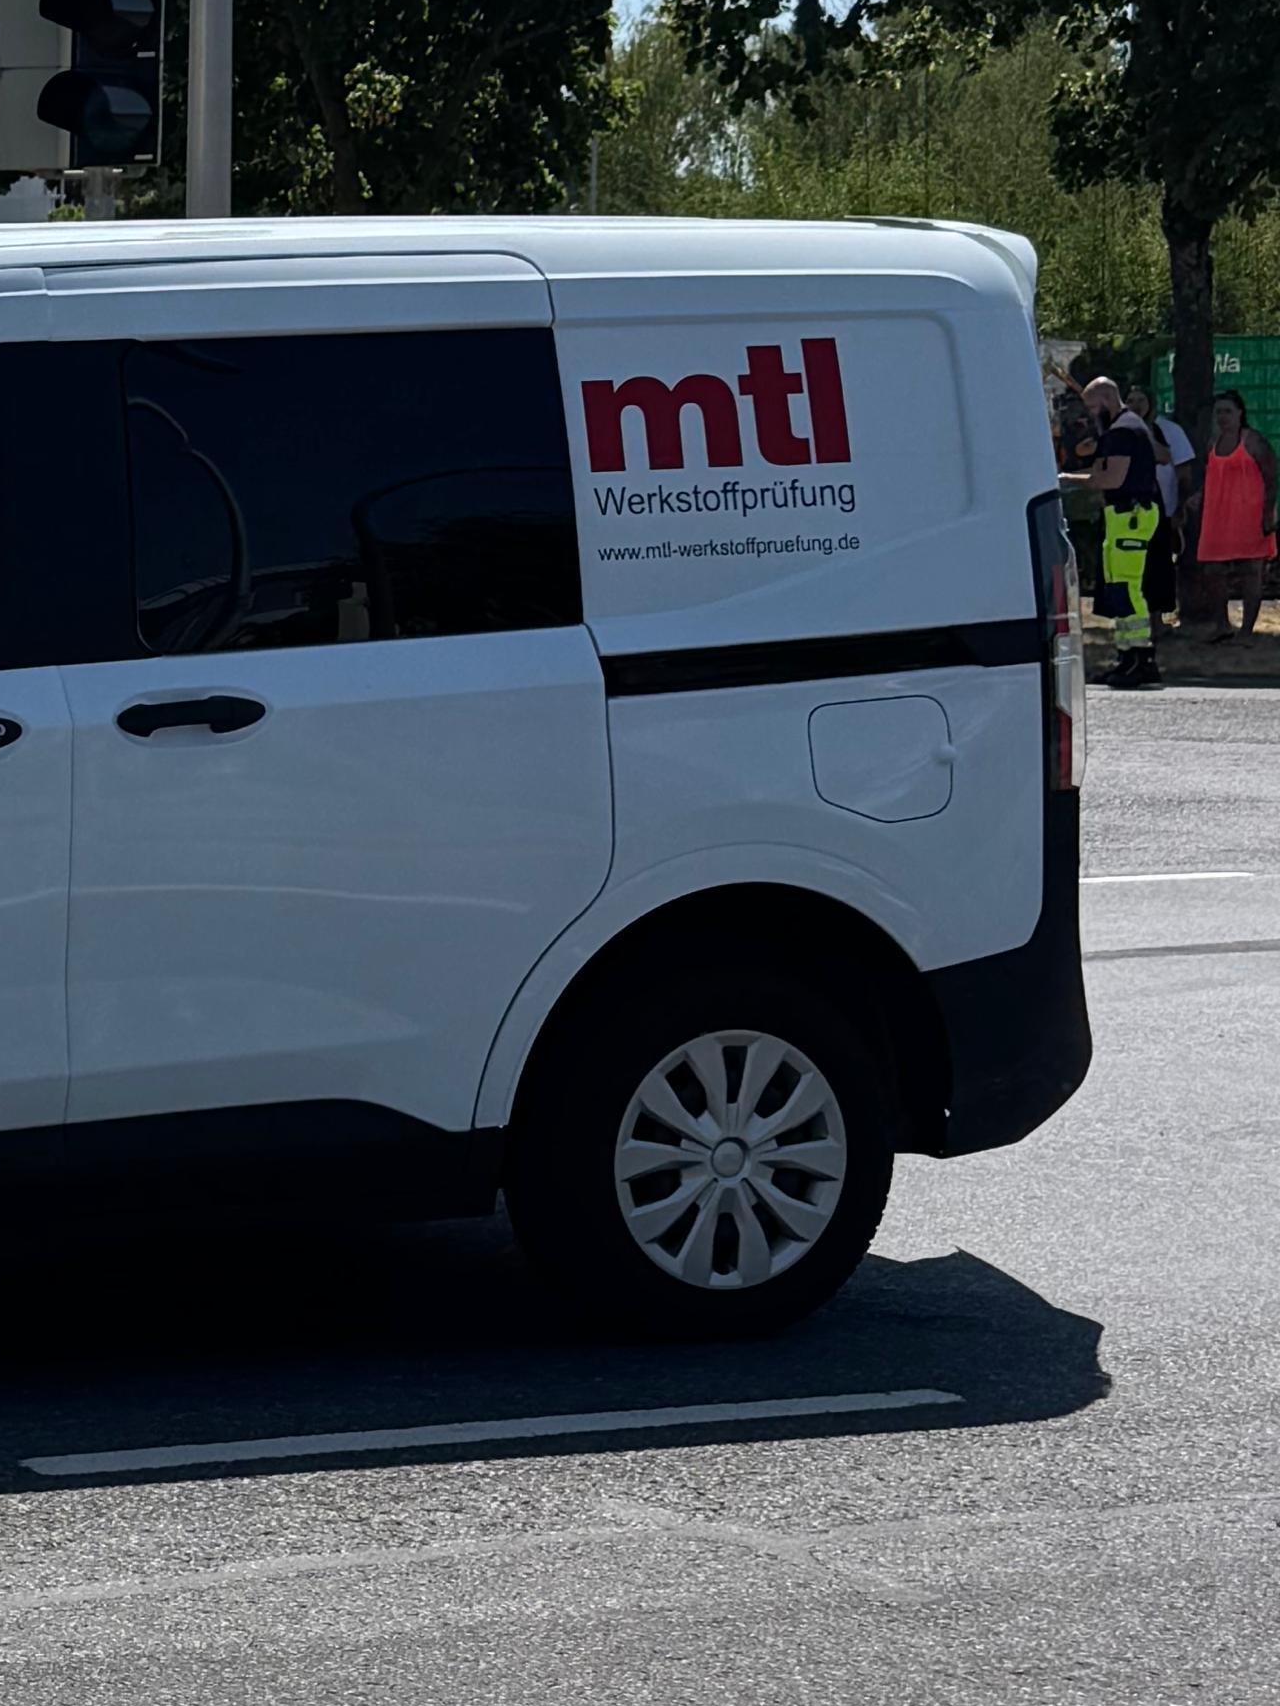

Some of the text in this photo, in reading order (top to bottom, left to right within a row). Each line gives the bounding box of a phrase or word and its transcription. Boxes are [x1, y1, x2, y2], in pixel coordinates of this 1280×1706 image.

[581, 337, 852, 473] mtl
[593, 478, 857, 517] Werkstoffprüfung
[597, 533, 861, 562] www.mtl-werkstoffpruefung.de
